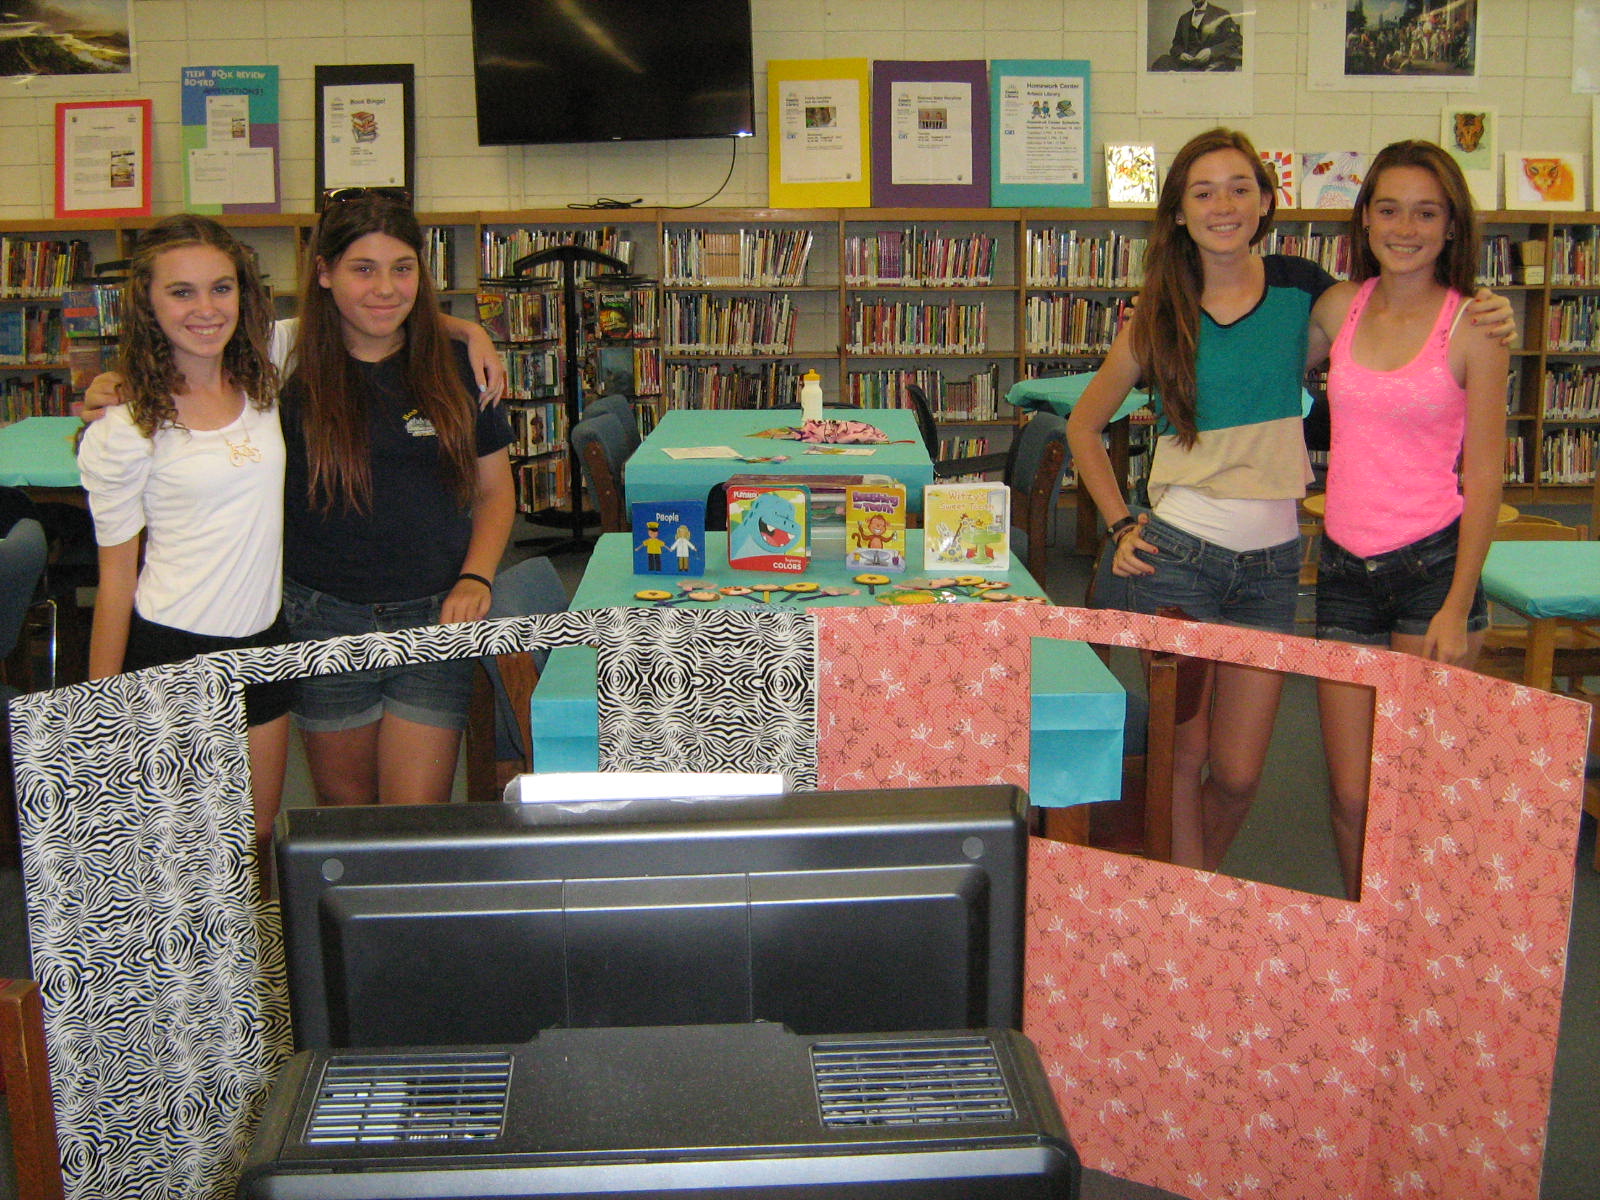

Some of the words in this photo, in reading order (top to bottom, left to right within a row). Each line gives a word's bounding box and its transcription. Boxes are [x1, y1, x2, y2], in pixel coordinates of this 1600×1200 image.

[211, 69, 233, 80] BOOK
[236, 71, 266, 79] REVIEW
[1026, 81, 1058, 89] Homework
[772, 561, 802, 570] COLORS
